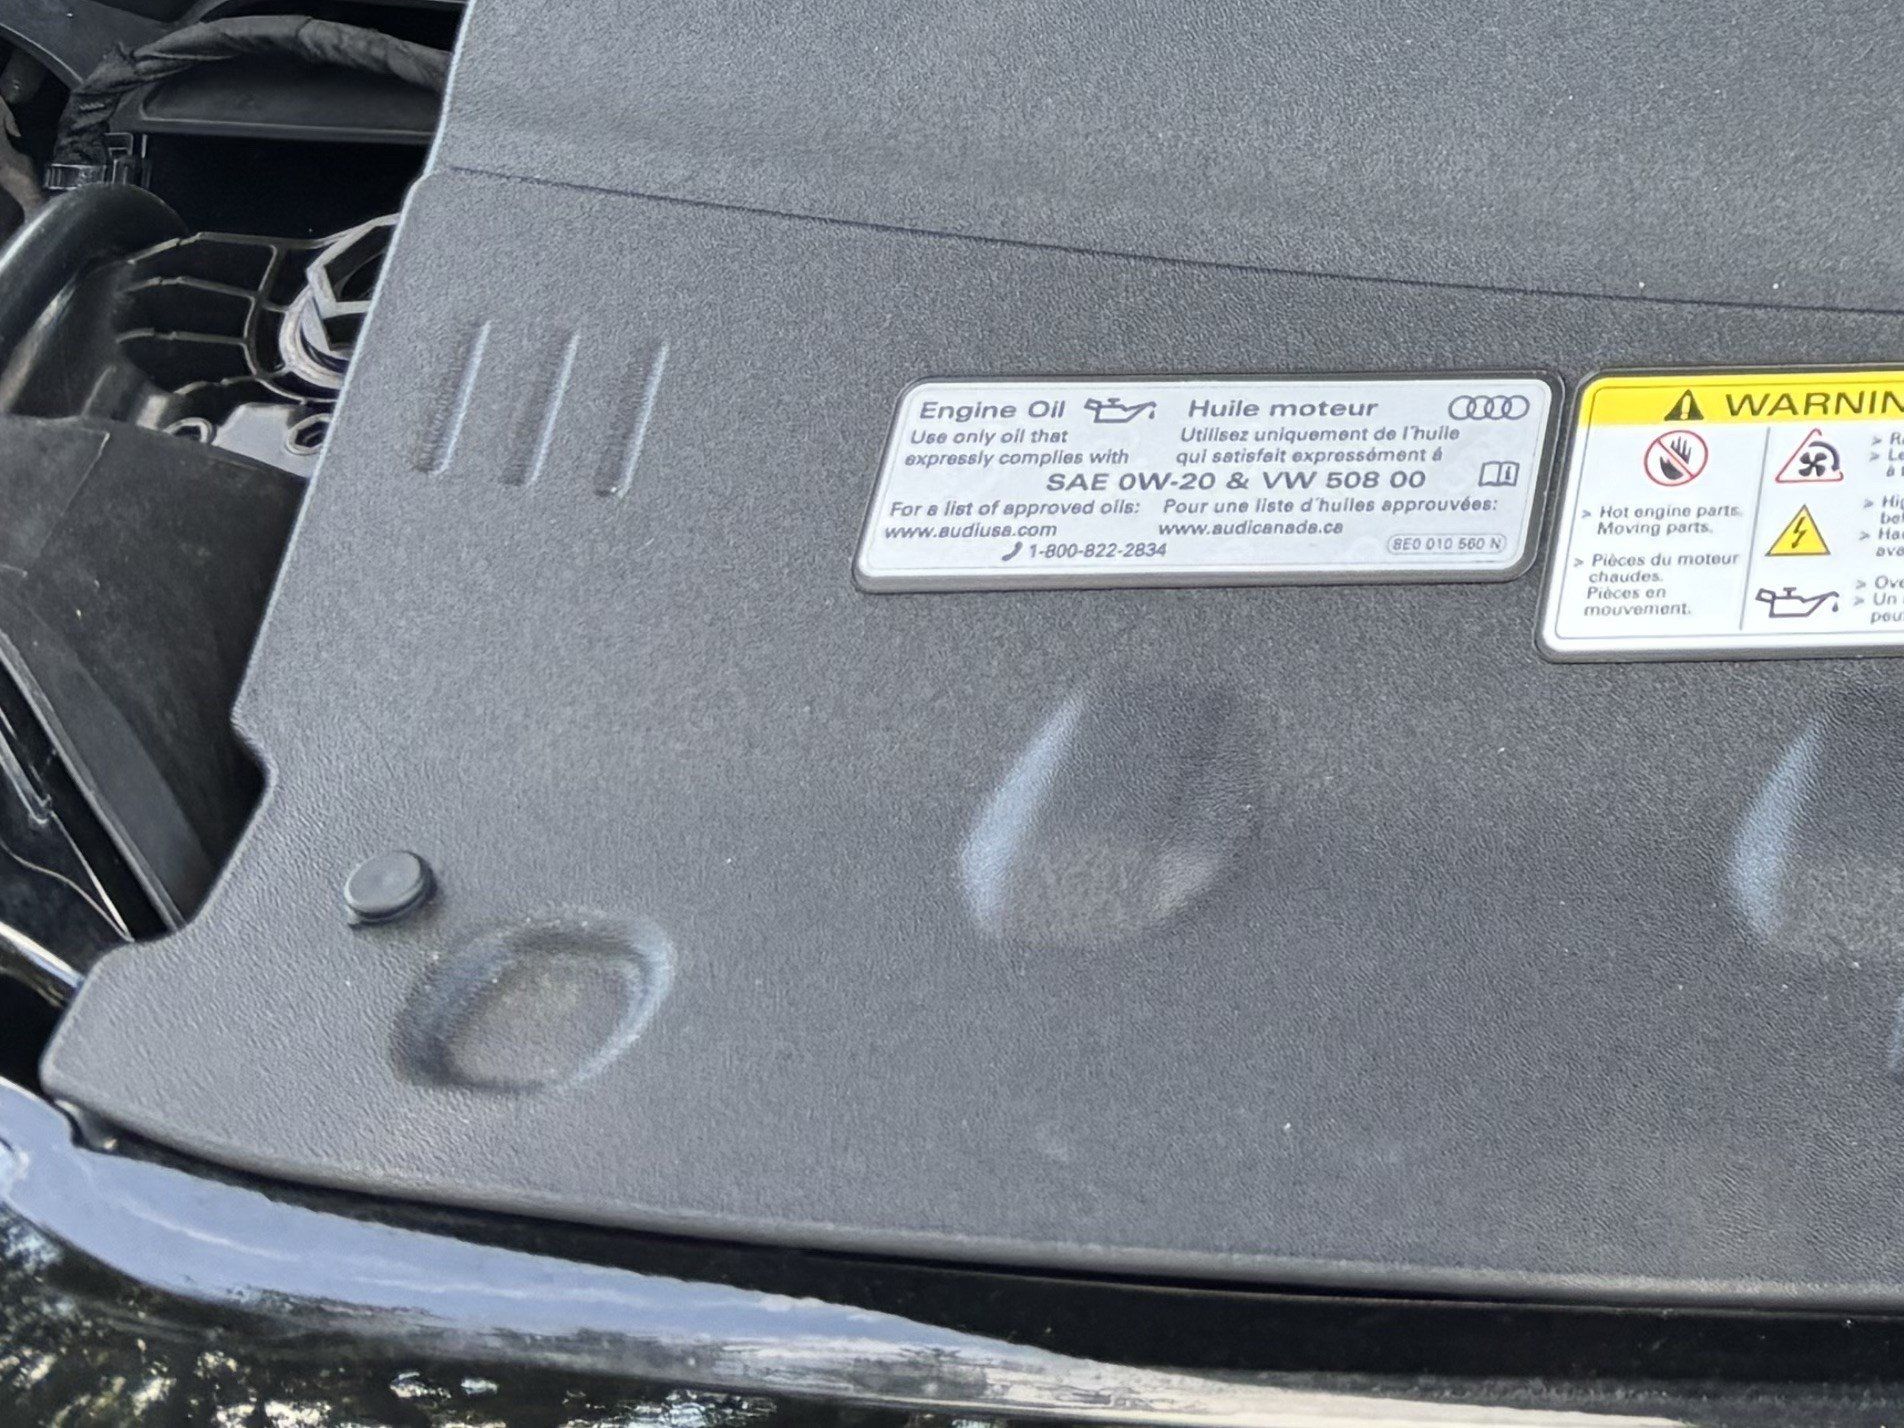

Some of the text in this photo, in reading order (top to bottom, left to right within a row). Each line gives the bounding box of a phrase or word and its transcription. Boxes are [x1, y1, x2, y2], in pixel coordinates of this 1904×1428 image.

[919, 400, 1065, 422] Engine Oil
[1188, 399, 1378, 417] Huile moteur
[910, 428, 1068, 446] Use only oil that
[1180, 427, 1249, 442] Utilisez
[1254, 426, 1368, 444] uniquement
[1373, 426, 1396, 441] de
[904, 448, 1129, 468] expressly complies with
[1176, 449, 1207, 466] qui
[1212, 448, 1286, 463] satisfait
[1046, 470, 1425, 491] SAE 0W-20 & VW 508 00
[889, 499, 1140, 518] For a list of approved oils:
[1163, 498, 1209, 514] Pour
[1213, 501, 1249, 513] une
[1255, 498, 1294, 513] liste
[1381, 495, 1497, 515] approuvées:
[1600, 505, 1628, 518] Hot
[1634, 505, 1691, 520] engine
[885, 522, 1057, 539] www.audiusa.com
[1158, 519, 1343, 535] www.audicanada.ca
[1597, 521, 1660, 537] Moving
[1030, 542, 1166, 558] 1-800-822-2834
[1425, 537, 1452, 550] 010
[1592, 553, 1738, 566] Pièces du moteur
[1587, 586, 1666, 599] Pièces en
[1873, 592, 1897, 605] Un
